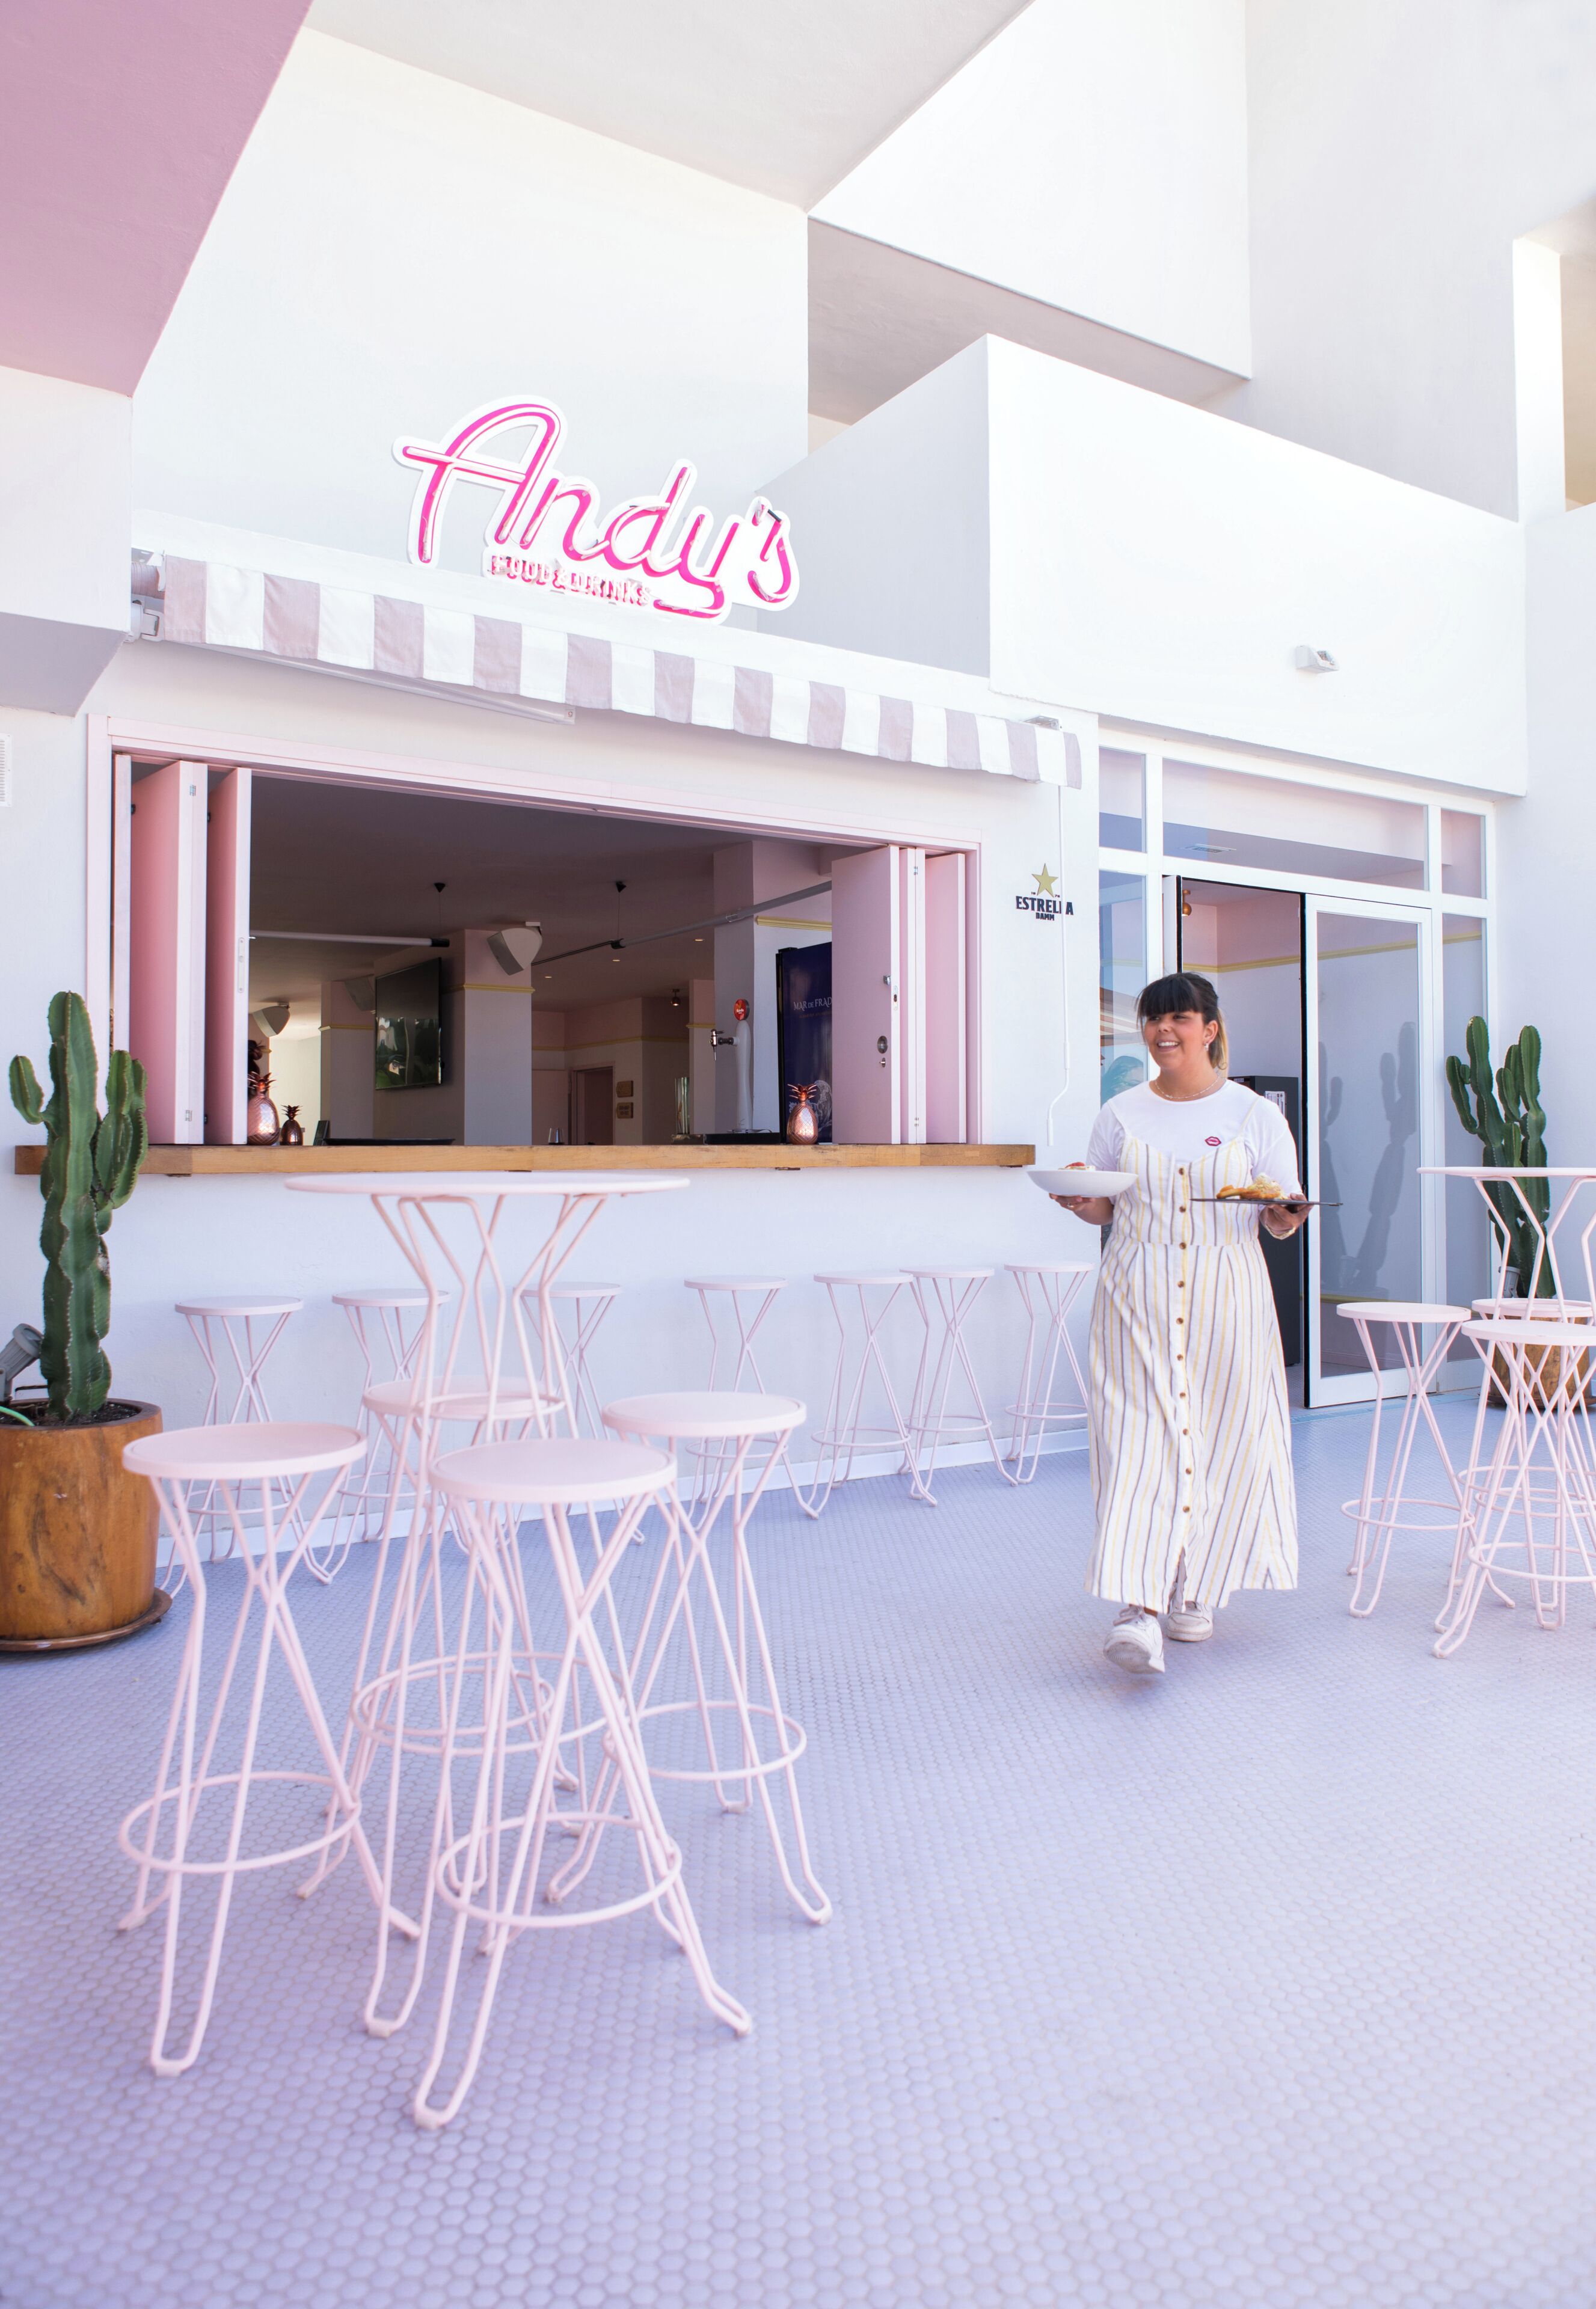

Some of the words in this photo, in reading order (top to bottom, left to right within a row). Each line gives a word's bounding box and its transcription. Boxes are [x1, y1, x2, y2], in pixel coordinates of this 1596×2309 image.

[402, 403, 792, 619] Andy's
[1036, 912, 1055, 921] DAMM
[793, 1001, 807, 1011] MAR
